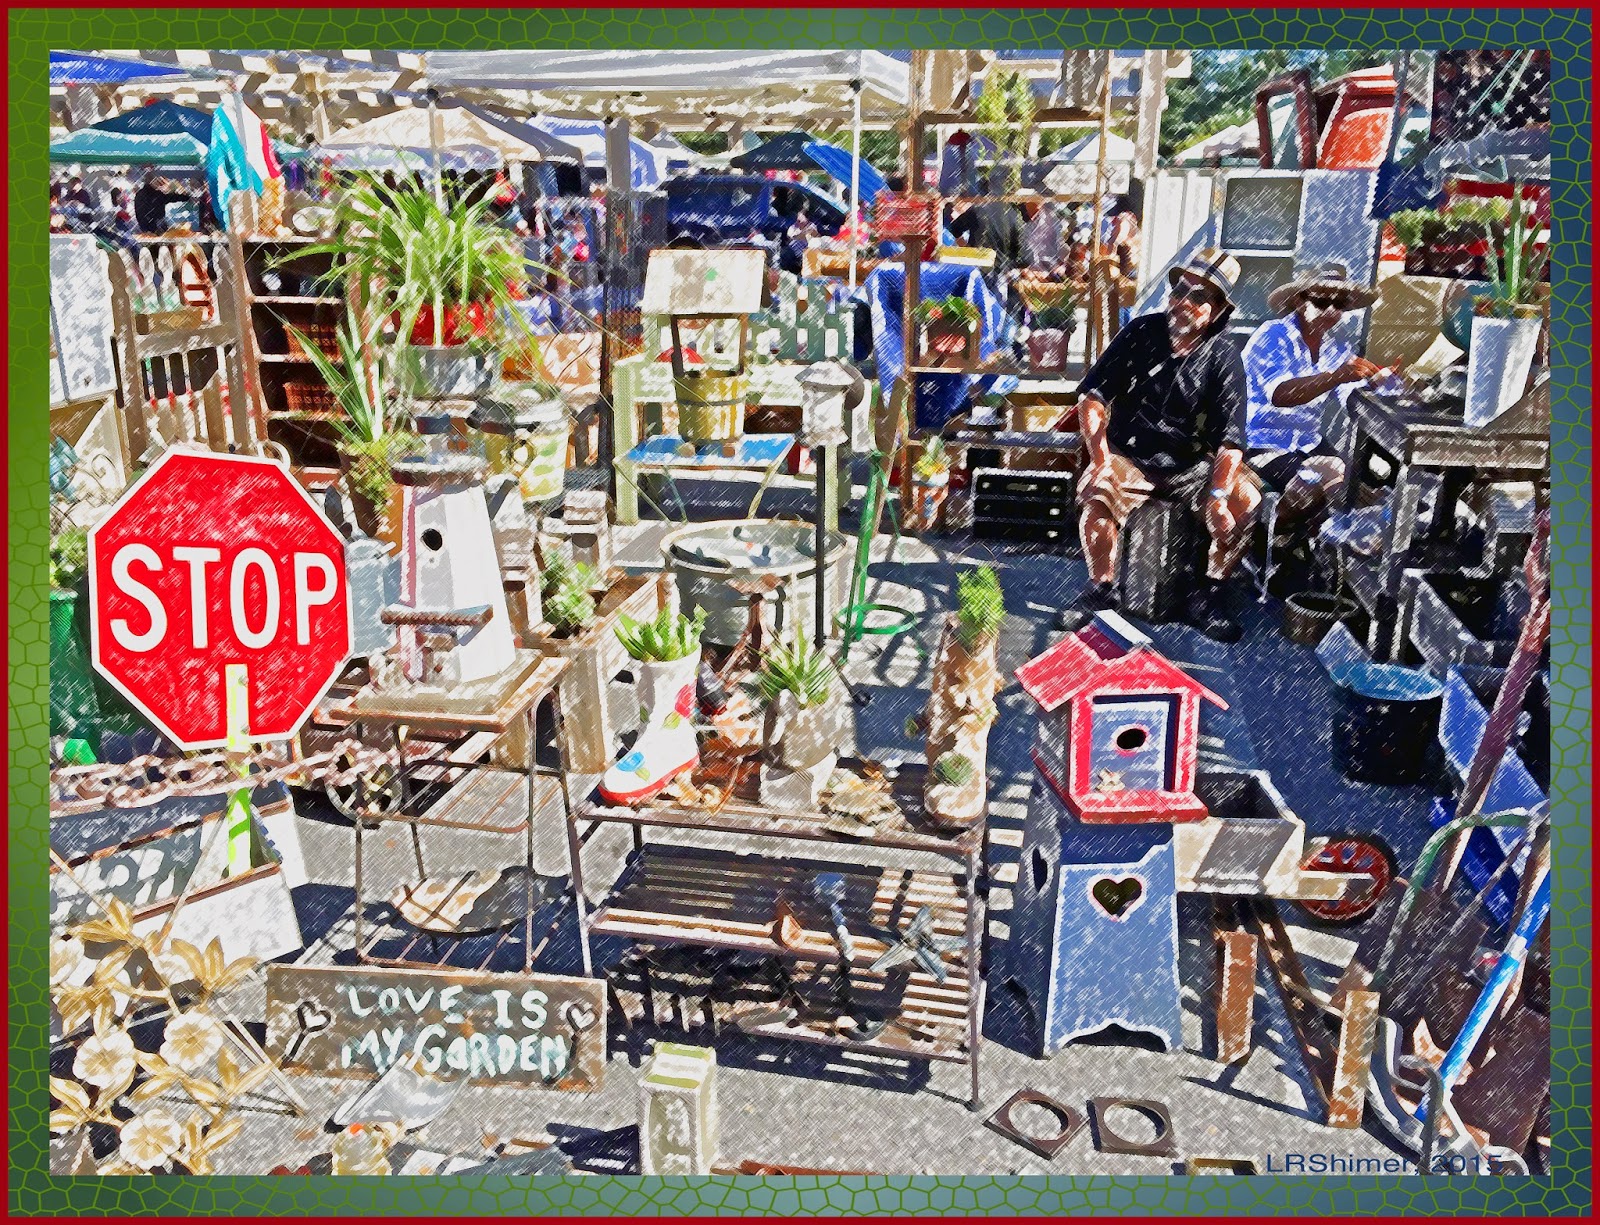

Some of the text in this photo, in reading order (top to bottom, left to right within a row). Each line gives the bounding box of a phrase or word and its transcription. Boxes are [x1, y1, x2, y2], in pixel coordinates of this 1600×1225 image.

[110, 543, 338, 653] STOP
[347, 984, 549, 1030] LOVE IS
[341, 1023, 570, 1080] MY GARDEN
